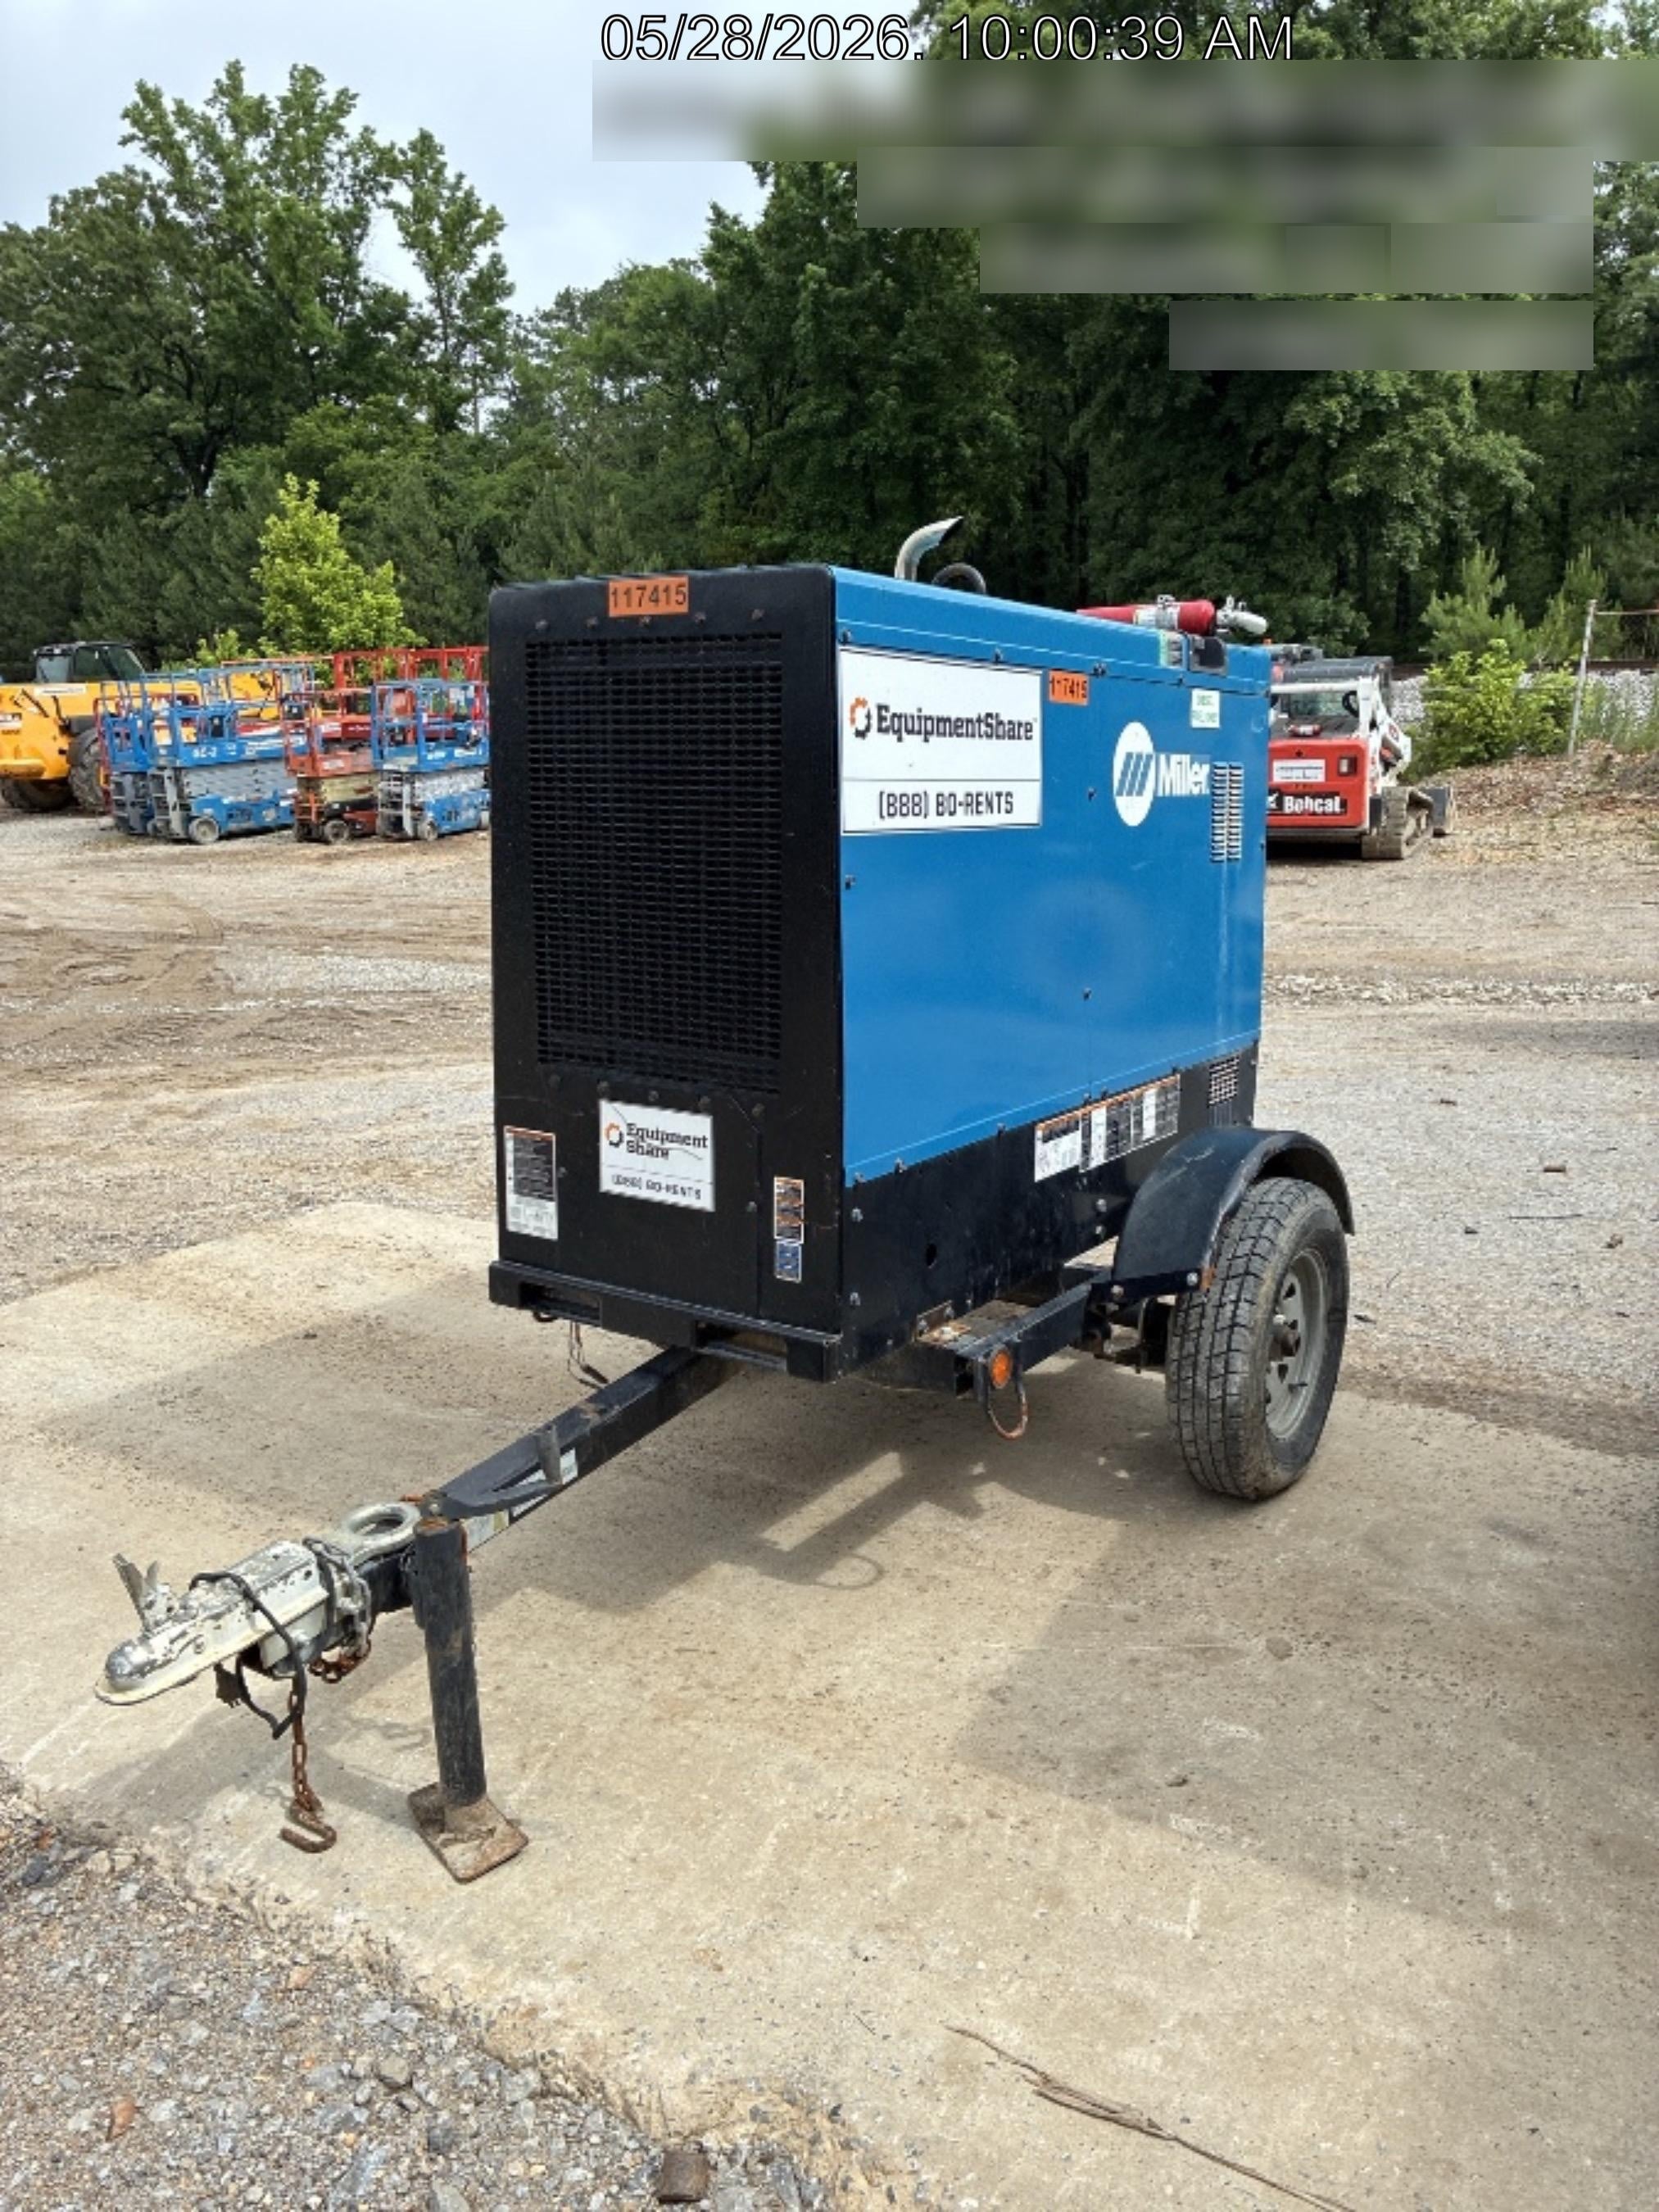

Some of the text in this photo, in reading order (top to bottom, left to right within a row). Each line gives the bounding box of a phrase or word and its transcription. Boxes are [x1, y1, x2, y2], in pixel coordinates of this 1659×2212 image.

[611, 582, 687, 608] 117415
[876, 704, 1034, 742] EquipmentShare
[1156, 754, 1210, 796] Miller
[1283, 795, 1341, 814] Bobcat
[627, 1122, 709, 1149] Equipment
[627, 1140, 669, 1160] Share
